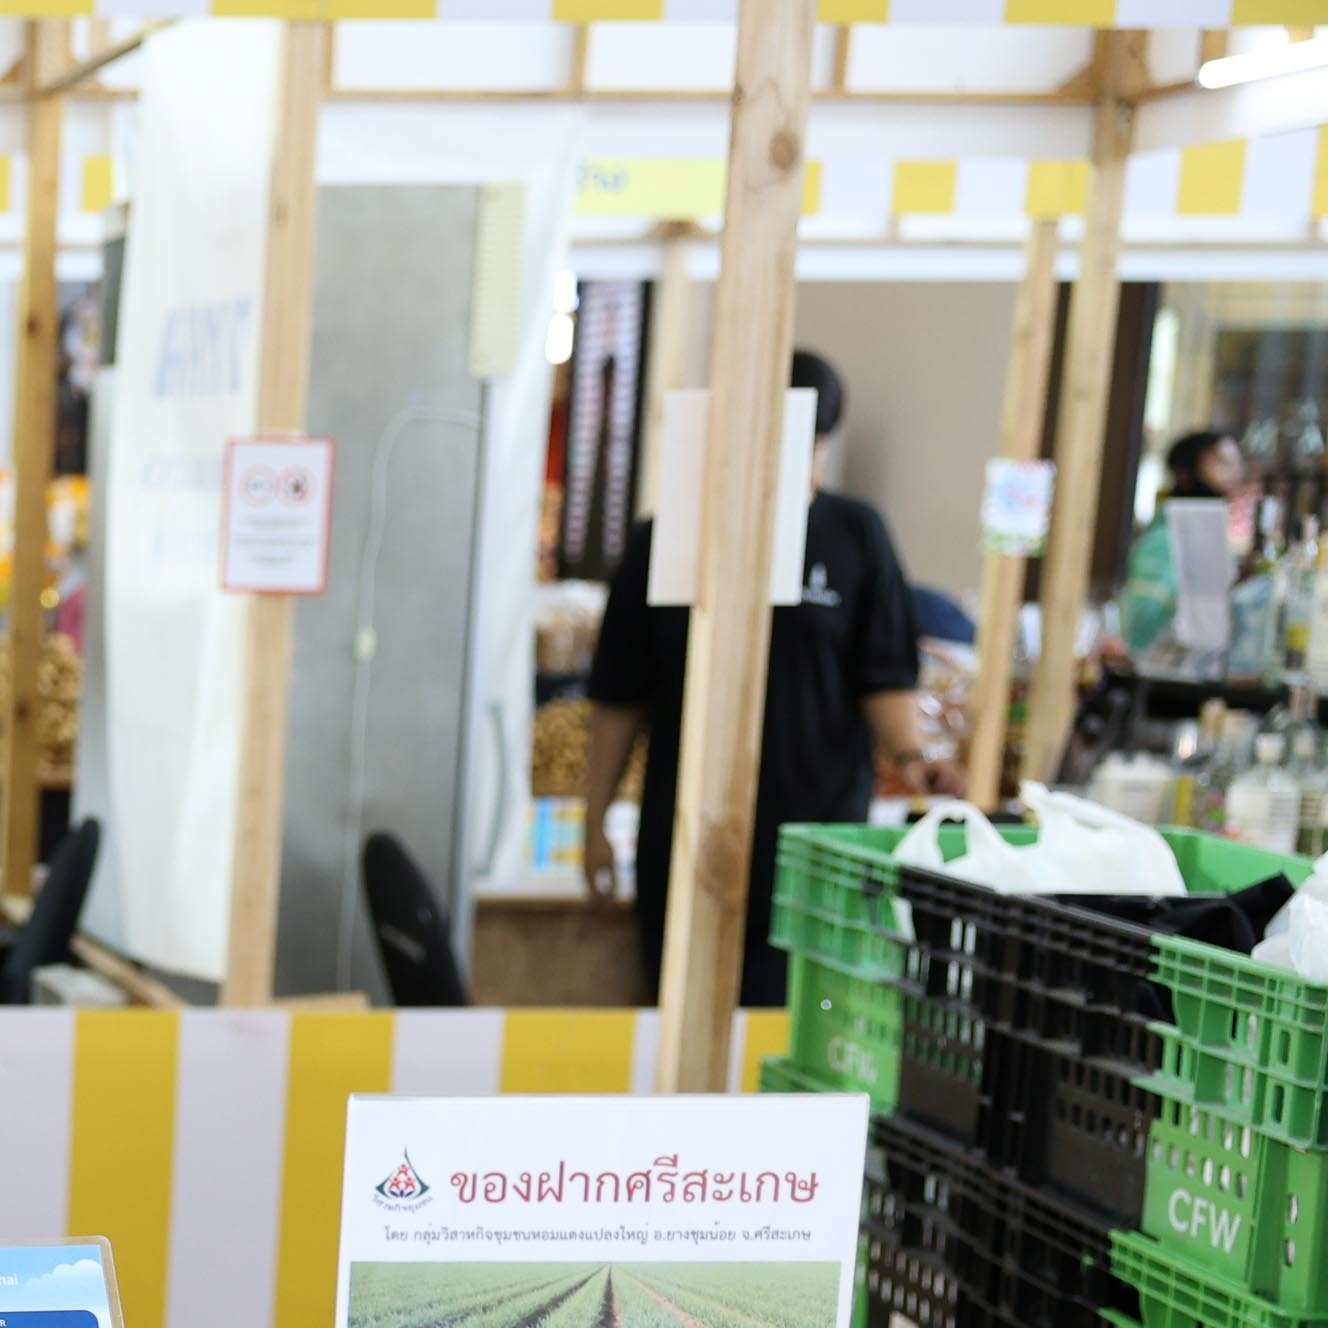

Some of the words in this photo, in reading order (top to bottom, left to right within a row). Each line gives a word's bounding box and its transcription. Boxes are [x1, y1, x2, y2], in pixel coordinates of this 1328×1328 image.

[449, 1153, 820, 1205] ของฝากศรีสะเกษ
[384, 1226, 409, 1242] โดย
[741, 1224, 812, 1243] จ.ศรีสะเกษ
[1167, 1188, 1242, 1254] CFW
